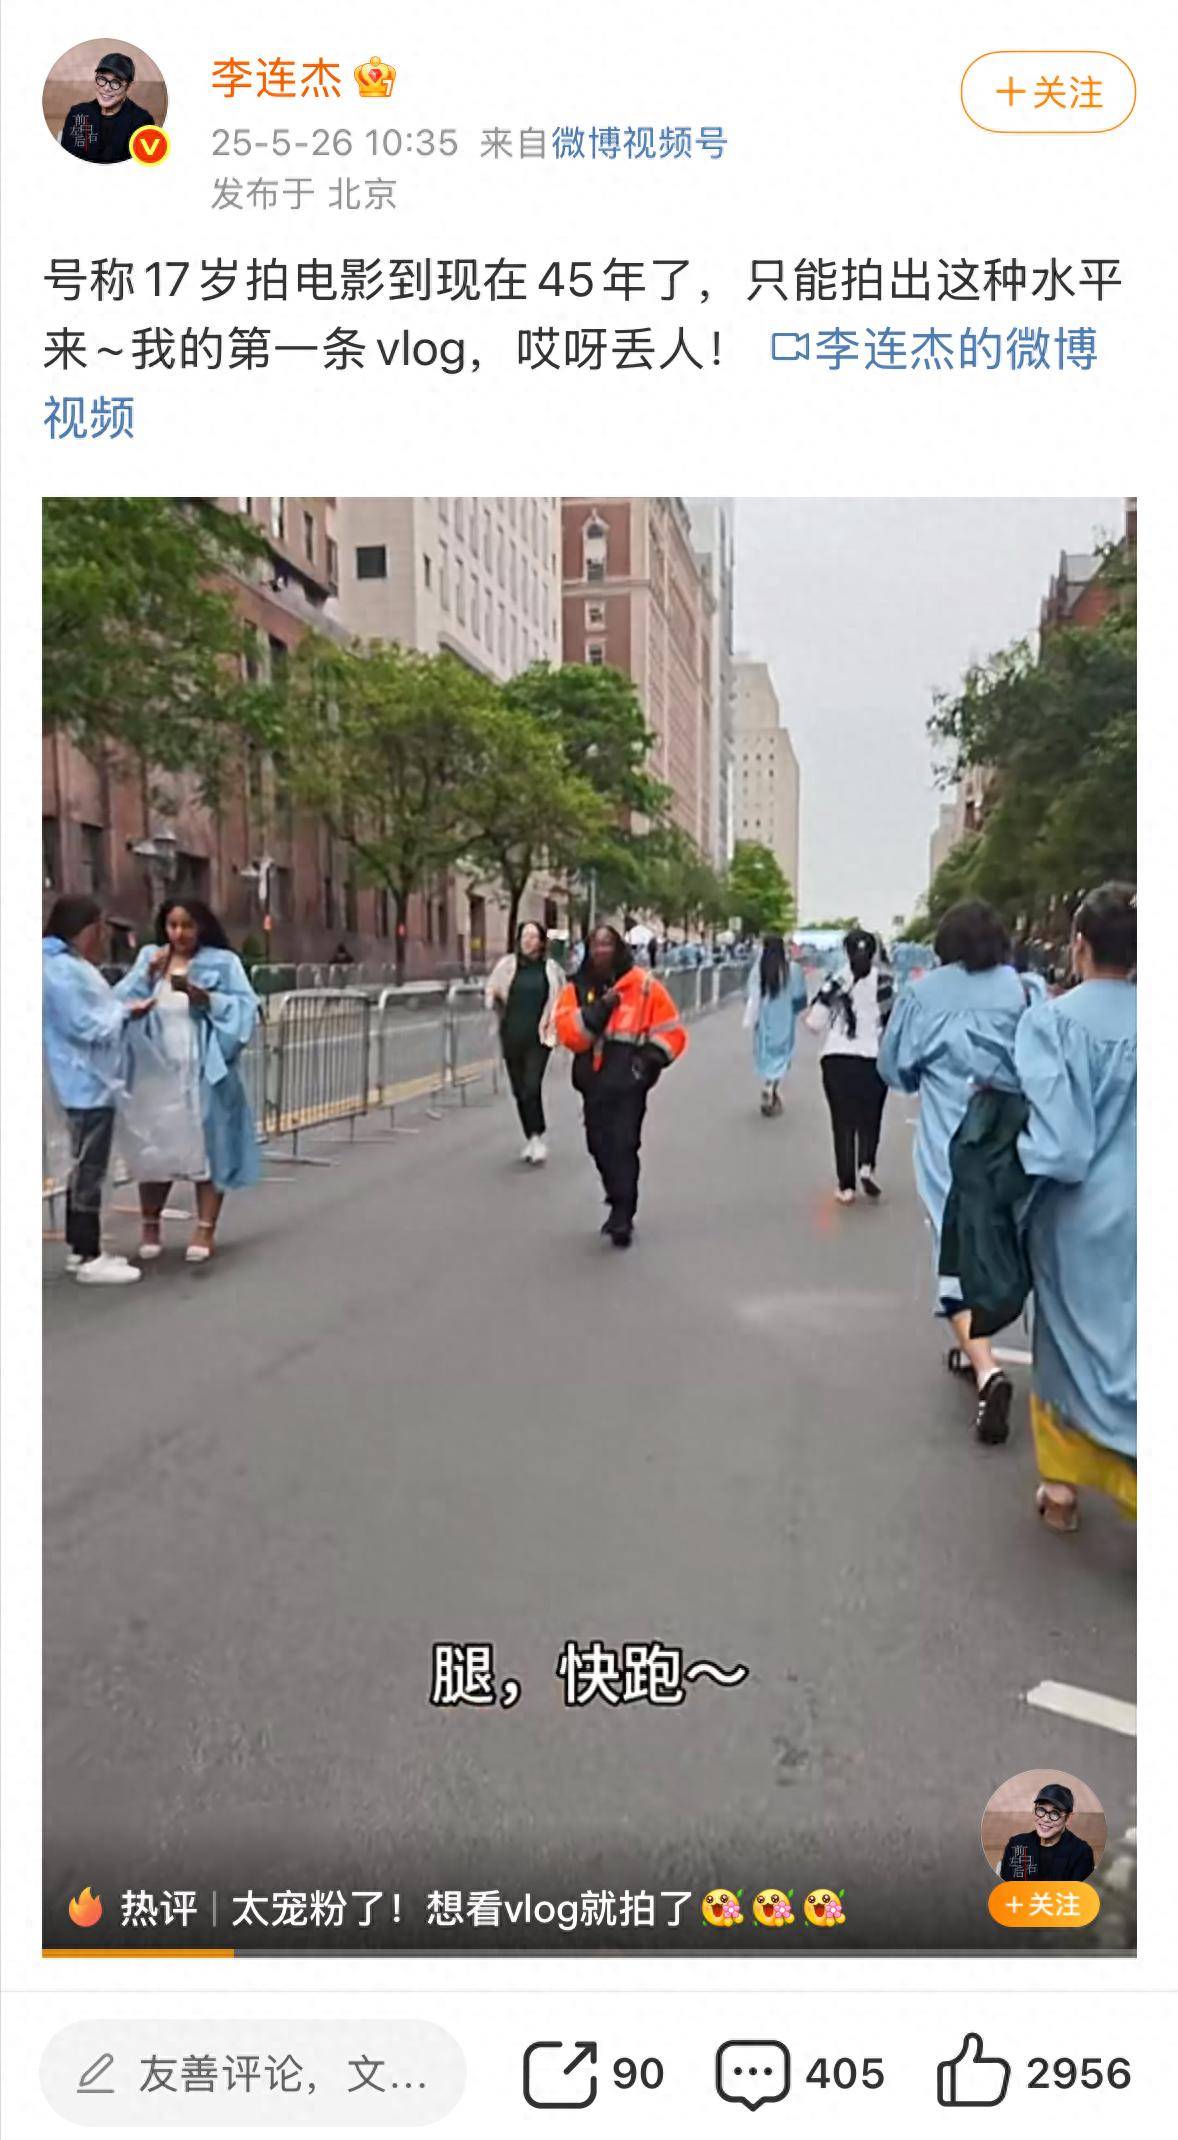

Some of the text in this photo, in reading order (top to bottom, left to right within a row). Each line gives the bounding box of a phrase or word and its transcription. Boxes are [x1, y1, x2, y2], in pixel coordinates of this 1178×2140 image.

[211, 56, 342, 99] 李连杰
[212, 126, 728, 160] 25-5-26 10:35 来自微博视频号
[211, 176, 397, 210] 发布于 北京
[815, 326, 1098, 371] 李连杰的微博
[43, 394, 135, 440] 视频
[612, 2056, 664, 2090] 90
[805, 2056, 885, 2090] 405
[1027, 2056, 1132, 2090] 2956
